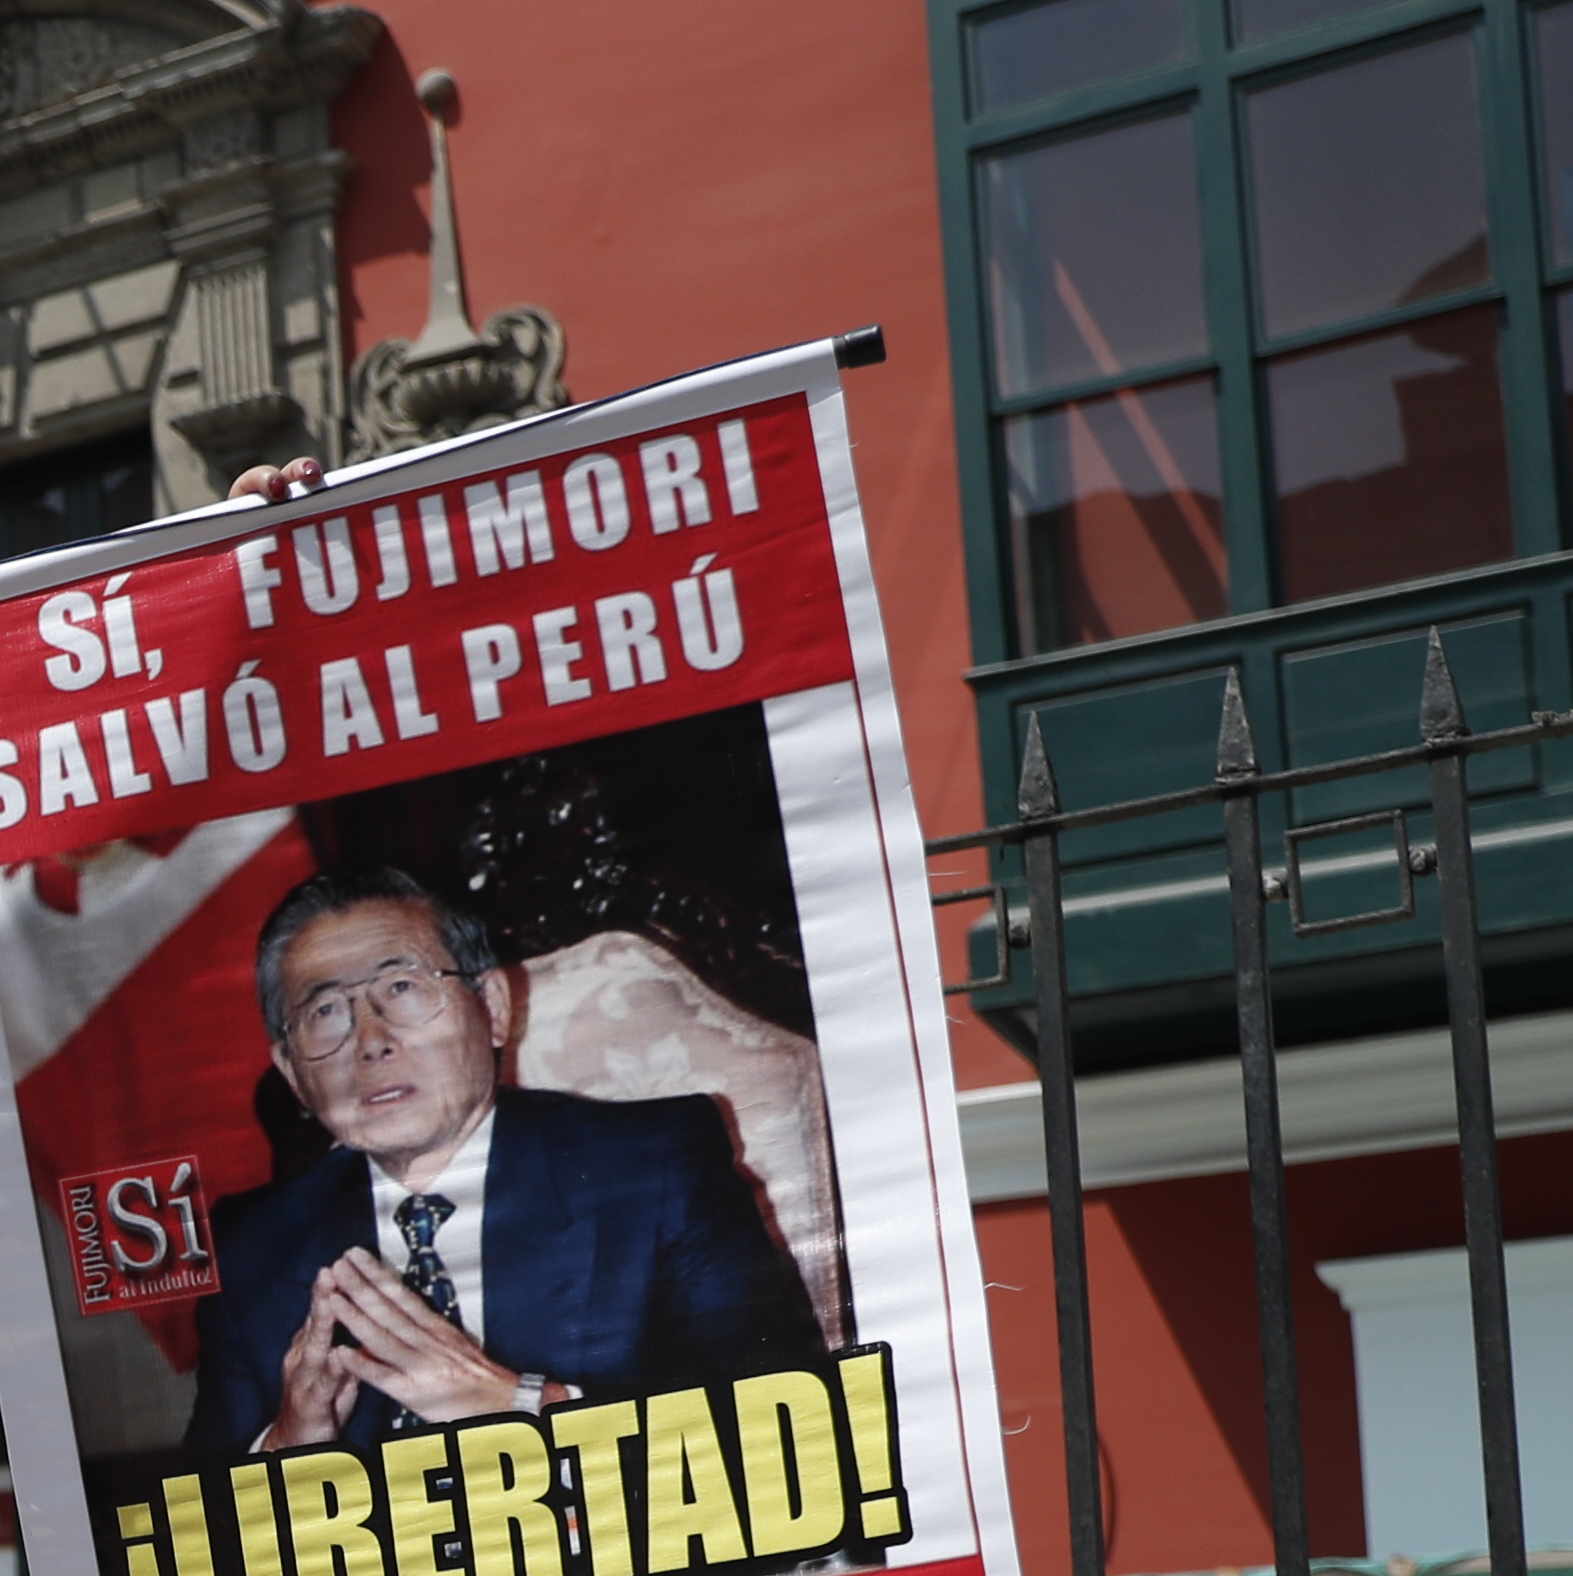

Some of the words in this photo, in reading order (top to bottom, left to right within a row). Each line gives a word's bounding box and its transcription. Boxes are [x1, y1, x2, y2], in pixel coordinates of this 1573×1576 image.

[38, 573, 163, 692] SÍ,
[235, 416, 759, 630] FUJIMORI
[319, 643, 439, 759] AL
[461, 553, 744, 725] PERÚ
[70, 1185, 111, 1304] FUJIMORI
[107, 1162, 208, 1272] Sí
